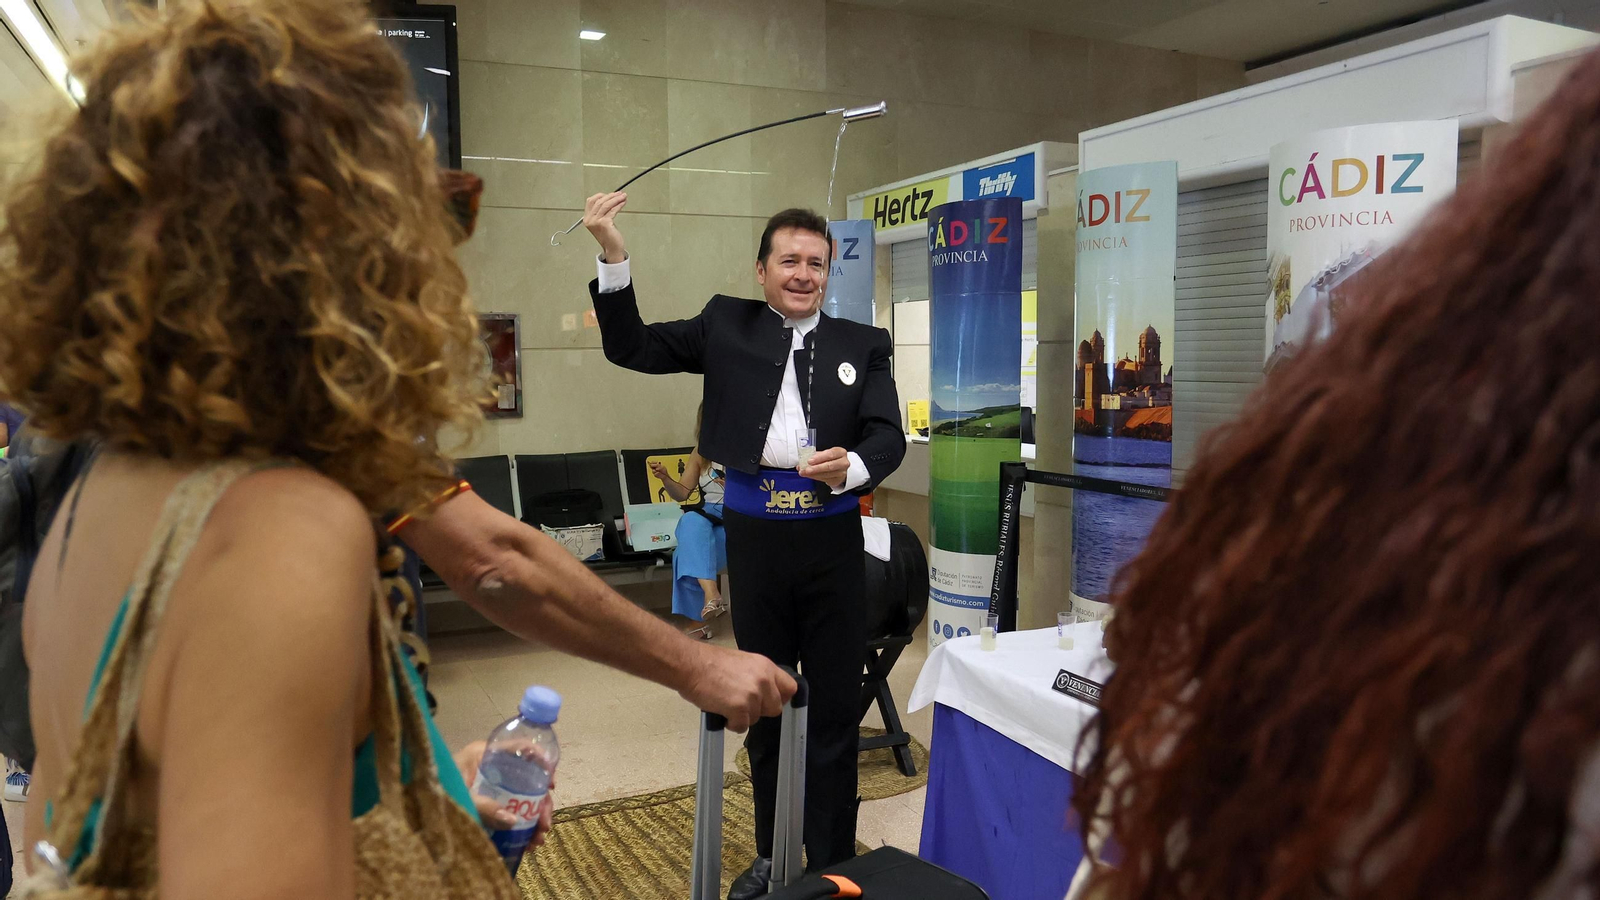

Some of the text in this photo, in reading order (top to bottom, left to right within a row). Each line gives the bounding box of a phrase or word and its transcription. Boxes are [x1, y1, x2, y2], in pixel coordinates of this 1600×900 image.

[388, 29, 413, 38] parking
[1278, 151, 1425, 207] CÁDIZ
[873, 187, 934, 228] Hertz
[1077, 188, 1151, 228] ÁDIZ
[1289, 210, 1394, 233] PROVINCIA
[928, 216, 1009, 252] CÁDIZ
[1077, 236, 1128, 252] OVINCIA
[931, 249, 988, 268] PROVINCIA
